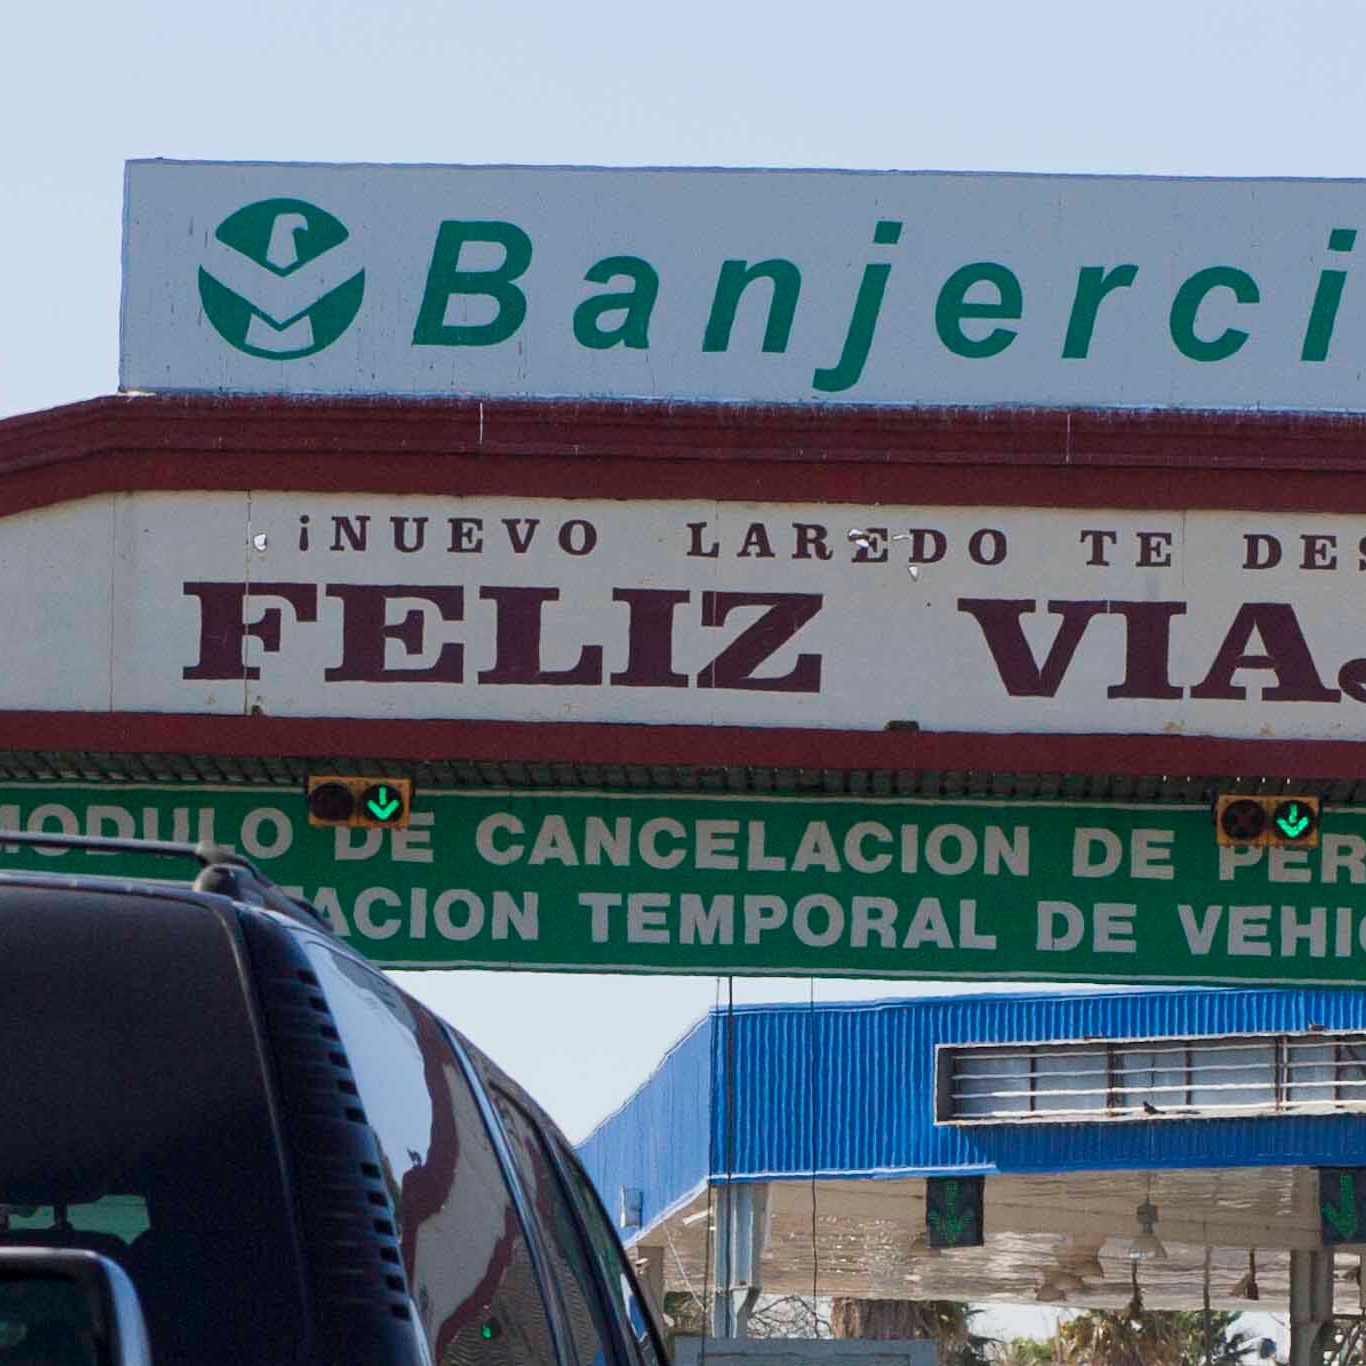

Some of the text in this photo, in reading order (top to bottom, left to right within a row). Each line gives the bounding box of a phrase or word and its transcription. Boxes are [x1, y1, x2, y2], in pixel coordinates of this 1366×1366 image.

[298, 514, 598, 556] ¡NUEVO
[686, 521, 1008, 566] LAREDO
[1079, 529, 1173, 568] TE
[182, 581, 825, 694] FELIZ
[335, 811, 434, 863] DE
[476, 813, 1030, 877] CANCELACION
[1072, 828, 1175, 880] DE
[578, 892, 997, 949] TEMPORAL
[1036, 900, 1137, 952] DE
